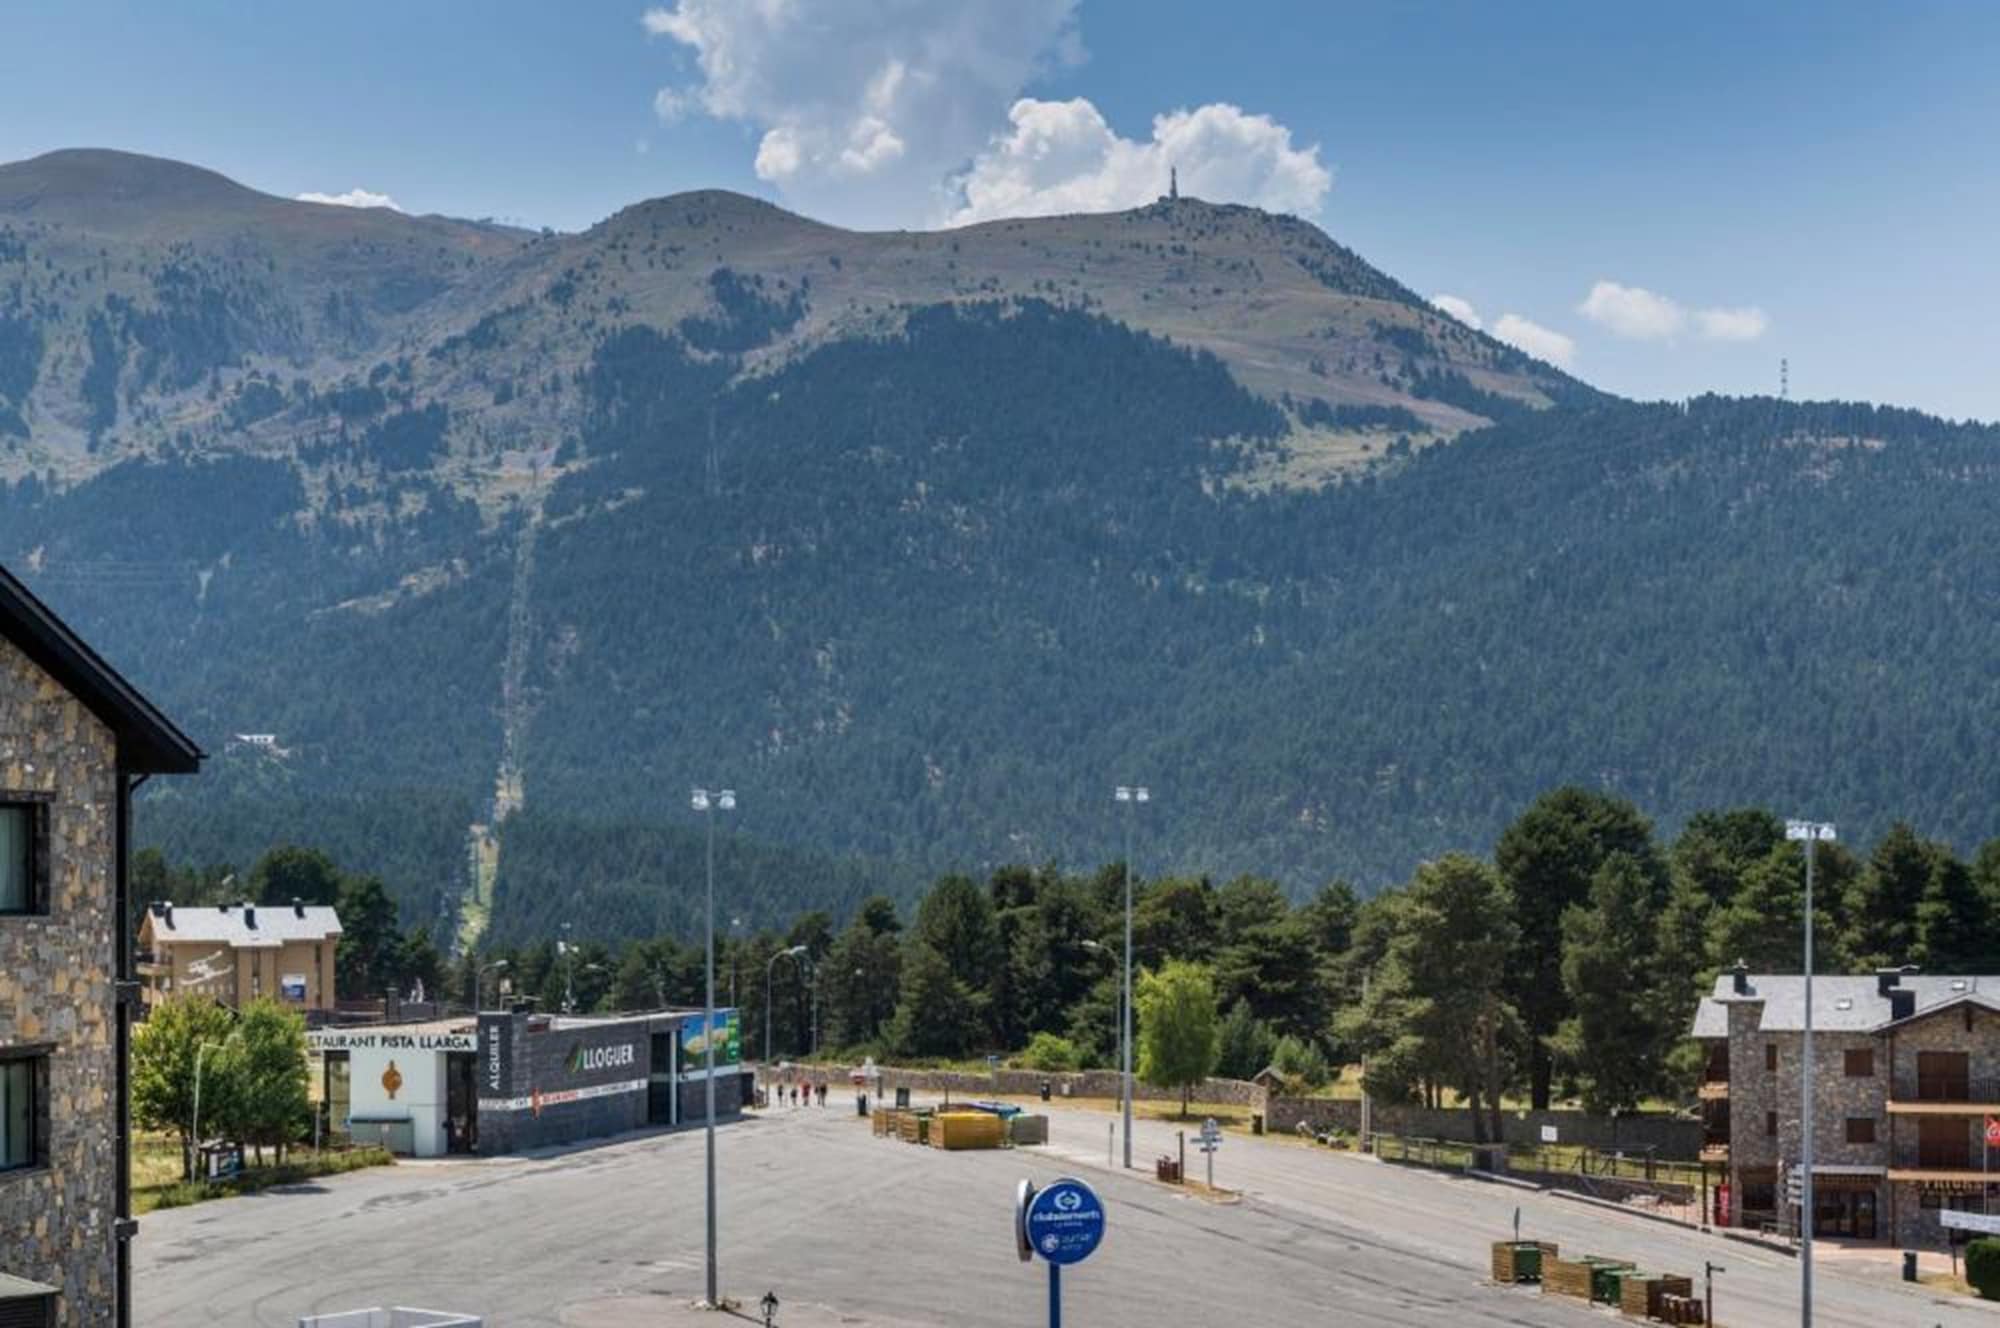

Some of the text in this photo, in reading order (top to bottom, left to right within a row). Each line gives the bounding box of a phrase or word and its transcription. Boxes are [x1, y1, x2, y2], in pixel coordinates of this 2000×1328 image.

[381, 1035, 415, 1048] PISTA
[420, 1036, 470, 1048] LLARGA
[489, 1025, 499, 1090] ALQUILER
[583, 1043, 634, 1069] LLOGUER
